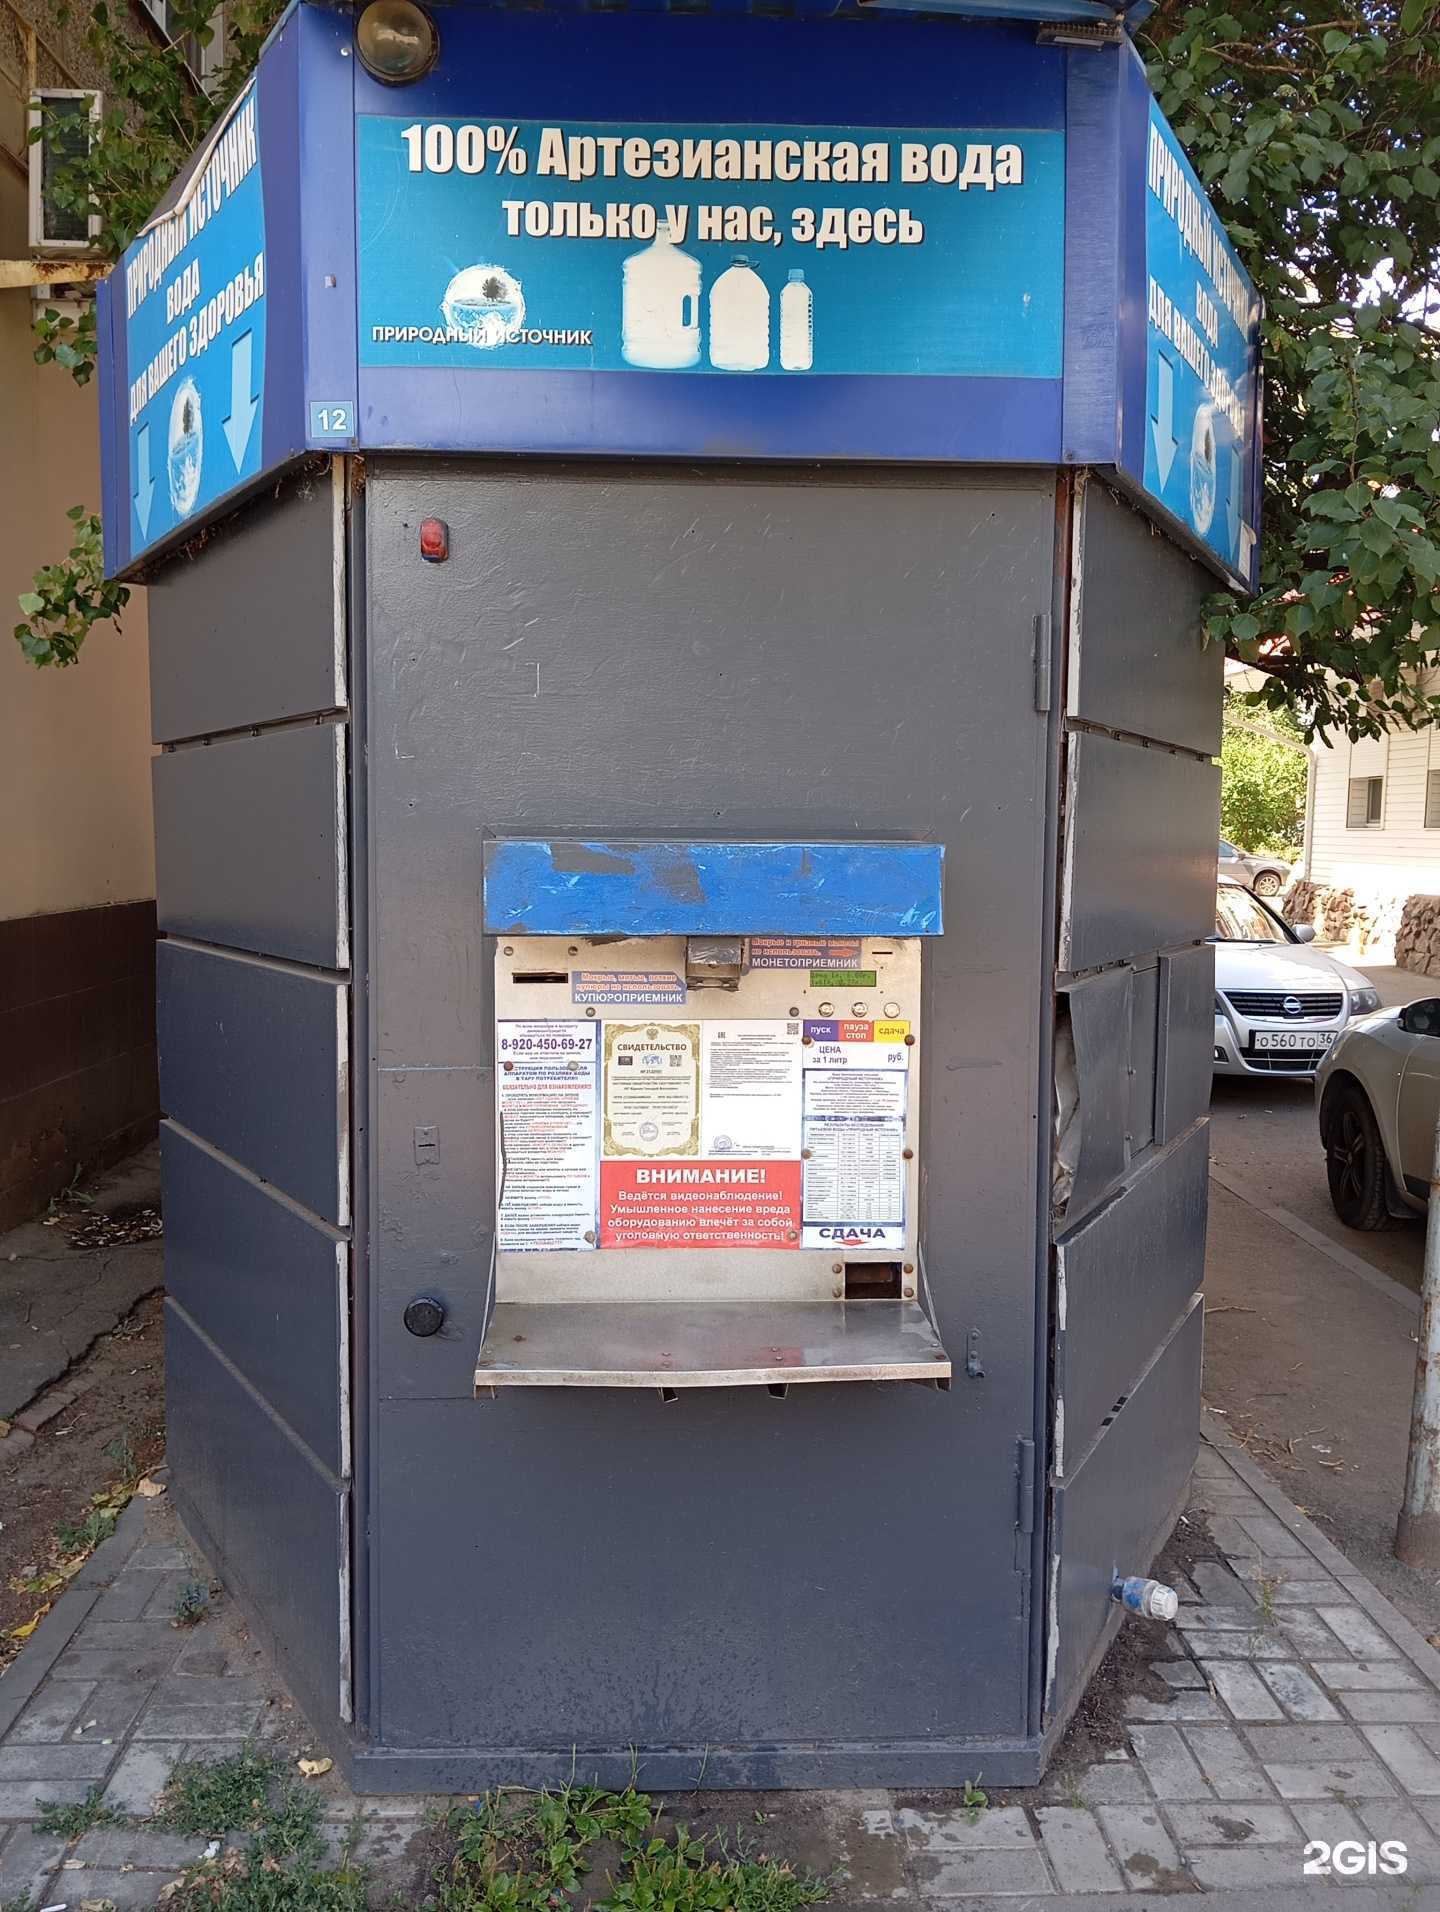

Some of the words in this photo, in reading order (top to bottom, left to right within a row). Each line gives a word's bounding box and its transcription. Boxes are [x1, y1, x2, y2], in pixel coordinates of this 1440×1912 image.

[401, 125, 527, 175] 100%
[537, 127, 889, 181] Артезианская
[902, 143, 1023, 191] вода
[1149, 119, 1212, 279] ПРИРОДНЫЙ
[502, 201, 656, 239] только
[665, 205, 689, 244] у
[698, 205, 781, 246] нас,
[791, 207, 924, 249] здесь
[166, 257, 200, 324] ВОДА
[1196, 280, 1218, 349] ВОДА
[372, 326, 490, 345] ПРИРОДНЫЙ
[494, 328, 593, 345] ИСТОЧНИК
[1149, 274, 1172, 342] ДЛЯ
[1173, 307, 1210, 389] ВАШЕГО
[130, 370, 148, 427] ДЛЯ
[148, 326, 187, 399] ВАШЕГО
[189, 252, 264, 357] ЗДОРОВЬЯ
[318, 408, 347, 431] 12
[752, 958, 858, 968] МОНЕТОПРИЕМНИК
[575, 993, 683, 1002] КУПЮРОПРИЕМНИК
[810, 1026, 832, 1034] пуск
[501, 1038, 593, 1050] 8-920-450-69-27
[1320, 1034, 1333, 1044] 36
[617, 1043, 687, 1052] СВИДЕТЕЛЬСТВО
[819, 1046, 841, 1054] ЦЕНА
[888, 1052, 904, 1062] руб.
[636, 1168, 766, 1184] ВНИМАНИЕ!
[618, 1190, 667, 1201] Ведётся
[670, 1191, 783, 1202] видеонаблюдение!
[610, 1204, 688, 1214] Умышленное
[691, 1204, 752, 1214] нанесение
[756, 1205, 791, 1215] вреда
[608, 1217, 696, 1229] оборудованию
[700, 1217, 739, 1227] влечёт
[742, 1219, 754, 1227] за
[758, 1217, 793, 1228] собой
[615, 1231, 680, 1242] уголовную
[683, 1231, 784, 1241] ответственность!
[819, 1228, 886, 1239] СДАЧА
